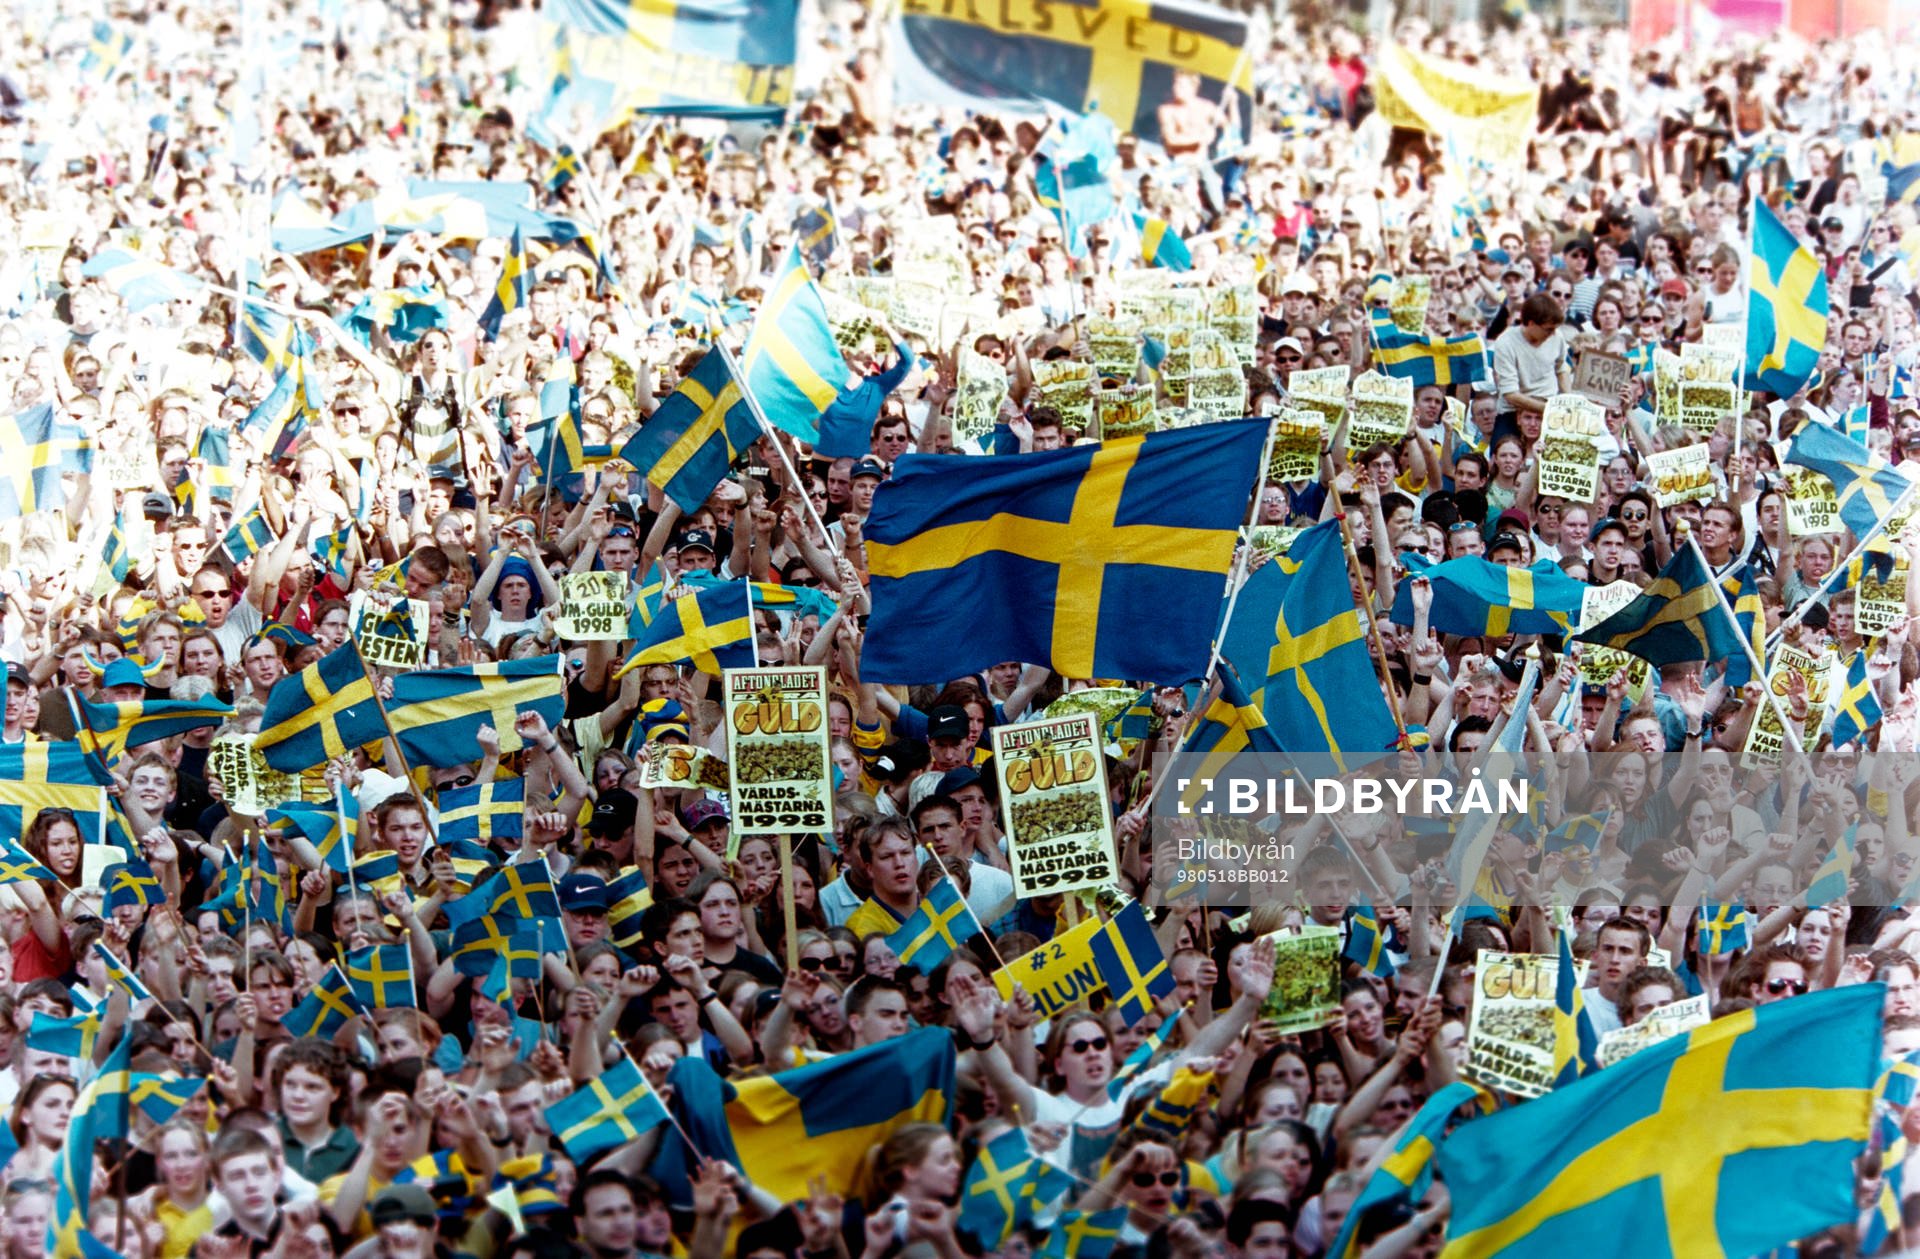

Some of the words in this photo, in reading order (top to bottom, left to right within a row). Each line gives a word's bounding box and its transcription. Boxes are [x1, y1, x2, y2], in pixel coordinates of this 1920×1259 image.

[1541, 482, 1591, 498] 1998
[1658, 467, 1713, 495] GULD
[1803, 514, 1830, 529] 1998
[576, 575, 600, 599] 20
[573, 617, 612, 634] 1998
[361, 635, 420, 665] ESTEN
[734, 674, 817, 691] AFTONBLADET
[733, 701, 822, 735] GULD
[1003, 721, 1088, 749] AFTONBLADET
[1005, 749, 1097, 795] GULD
[738, 787, 800, 800] VÄRLDS-
[738, 800, 826, 813] MÄSTARNA
[739, 813, 826, 828] 1998
[1017, 841, 1082, 862] VÄRLDS-
[1019, 851, 1109, 877] MÄSTARNA
[1020, 865, 1111, 891] 1998
[1482, 964, 1557, 1000] GUL
